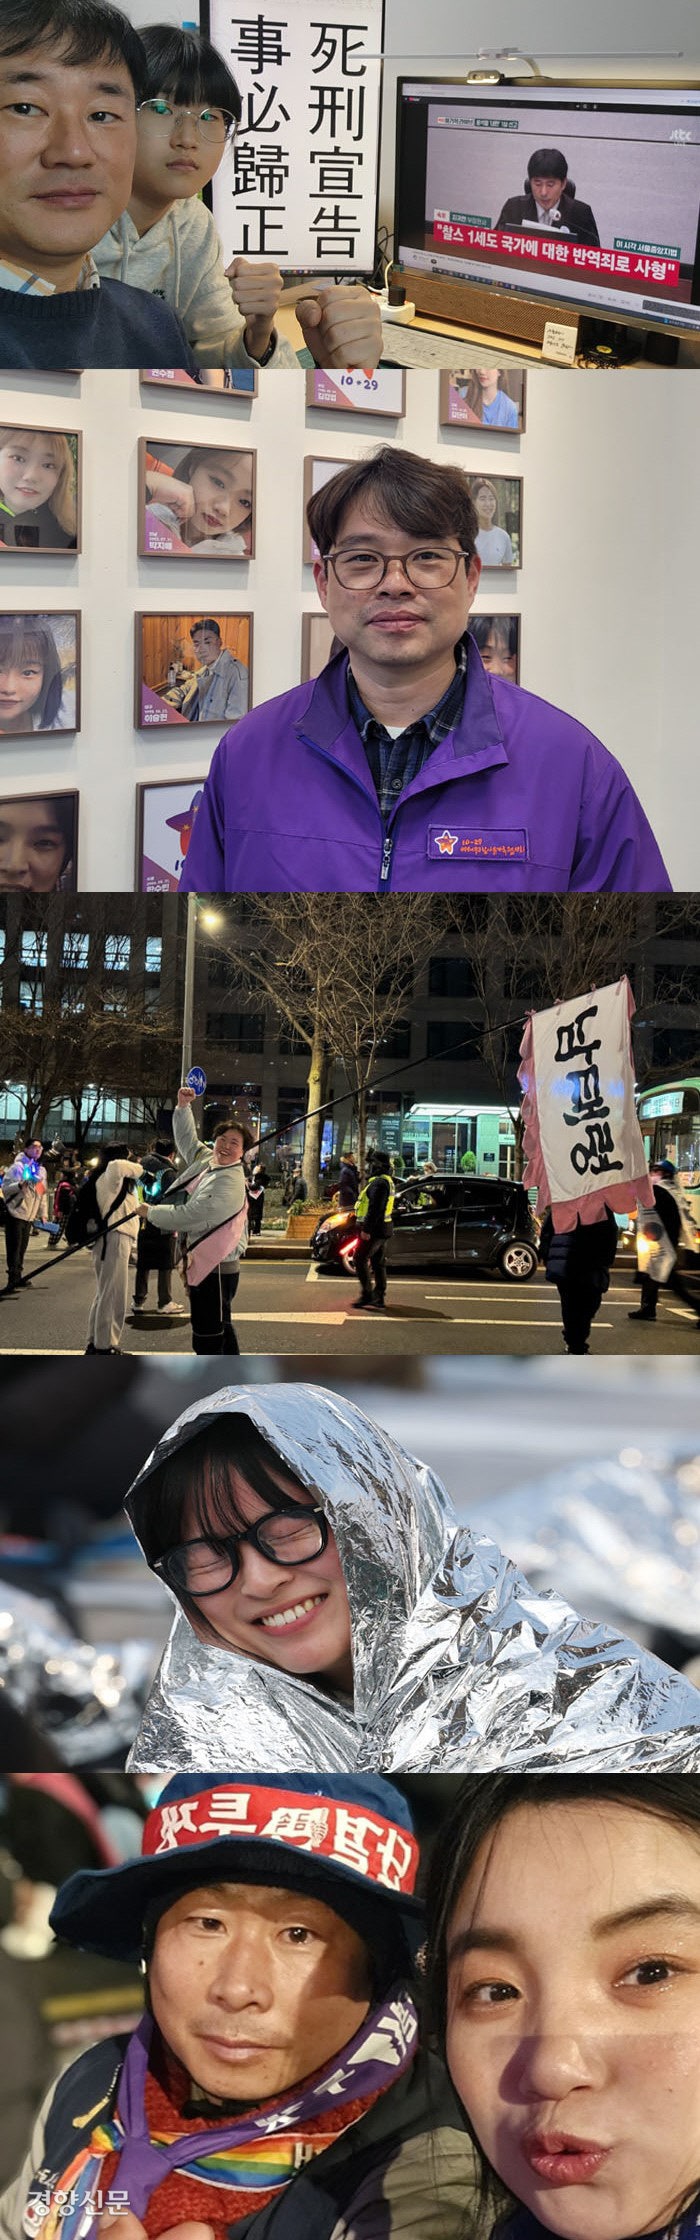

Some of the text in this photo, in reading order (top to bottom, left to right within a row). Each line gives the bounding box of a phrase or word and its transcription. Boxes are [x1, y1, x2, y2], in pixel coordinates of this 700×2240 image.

[231, 14, 291, 255] 事必歸正
[308, 22, 368, 258] 死刑宣告
[437, 223, 676, 281] "찰스 1세도 국가에 대한 반역죄로 사형"
[624, 241, 637, 250] 시각
[638, 244, 678, 257] 서울중앙지법
[554, 1005, 624, 1176] 남태령
